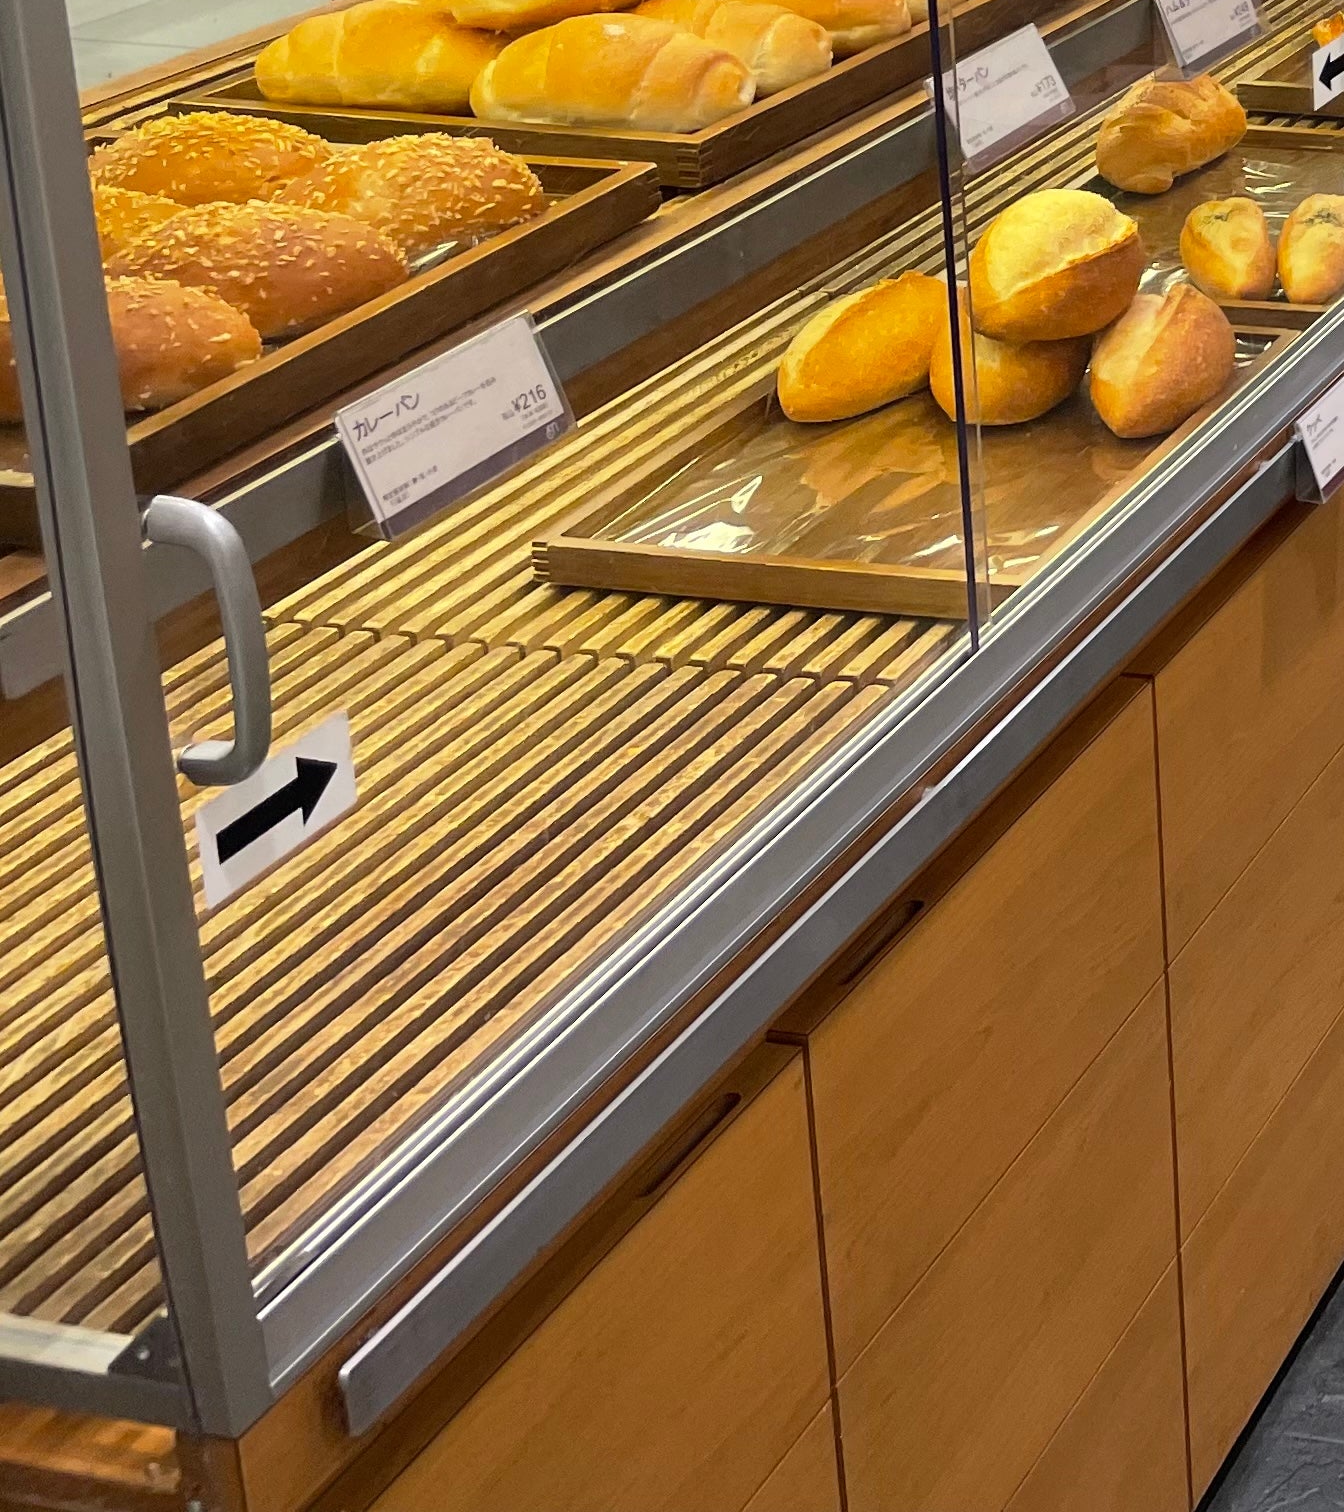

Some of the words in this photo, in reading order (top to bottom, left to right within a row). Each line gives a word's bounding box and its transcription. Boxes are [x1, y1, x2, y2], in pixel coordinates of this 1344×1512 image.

[352, 392, 420, 442] カレーパン
[511, 383, 548, 412] ¥216
